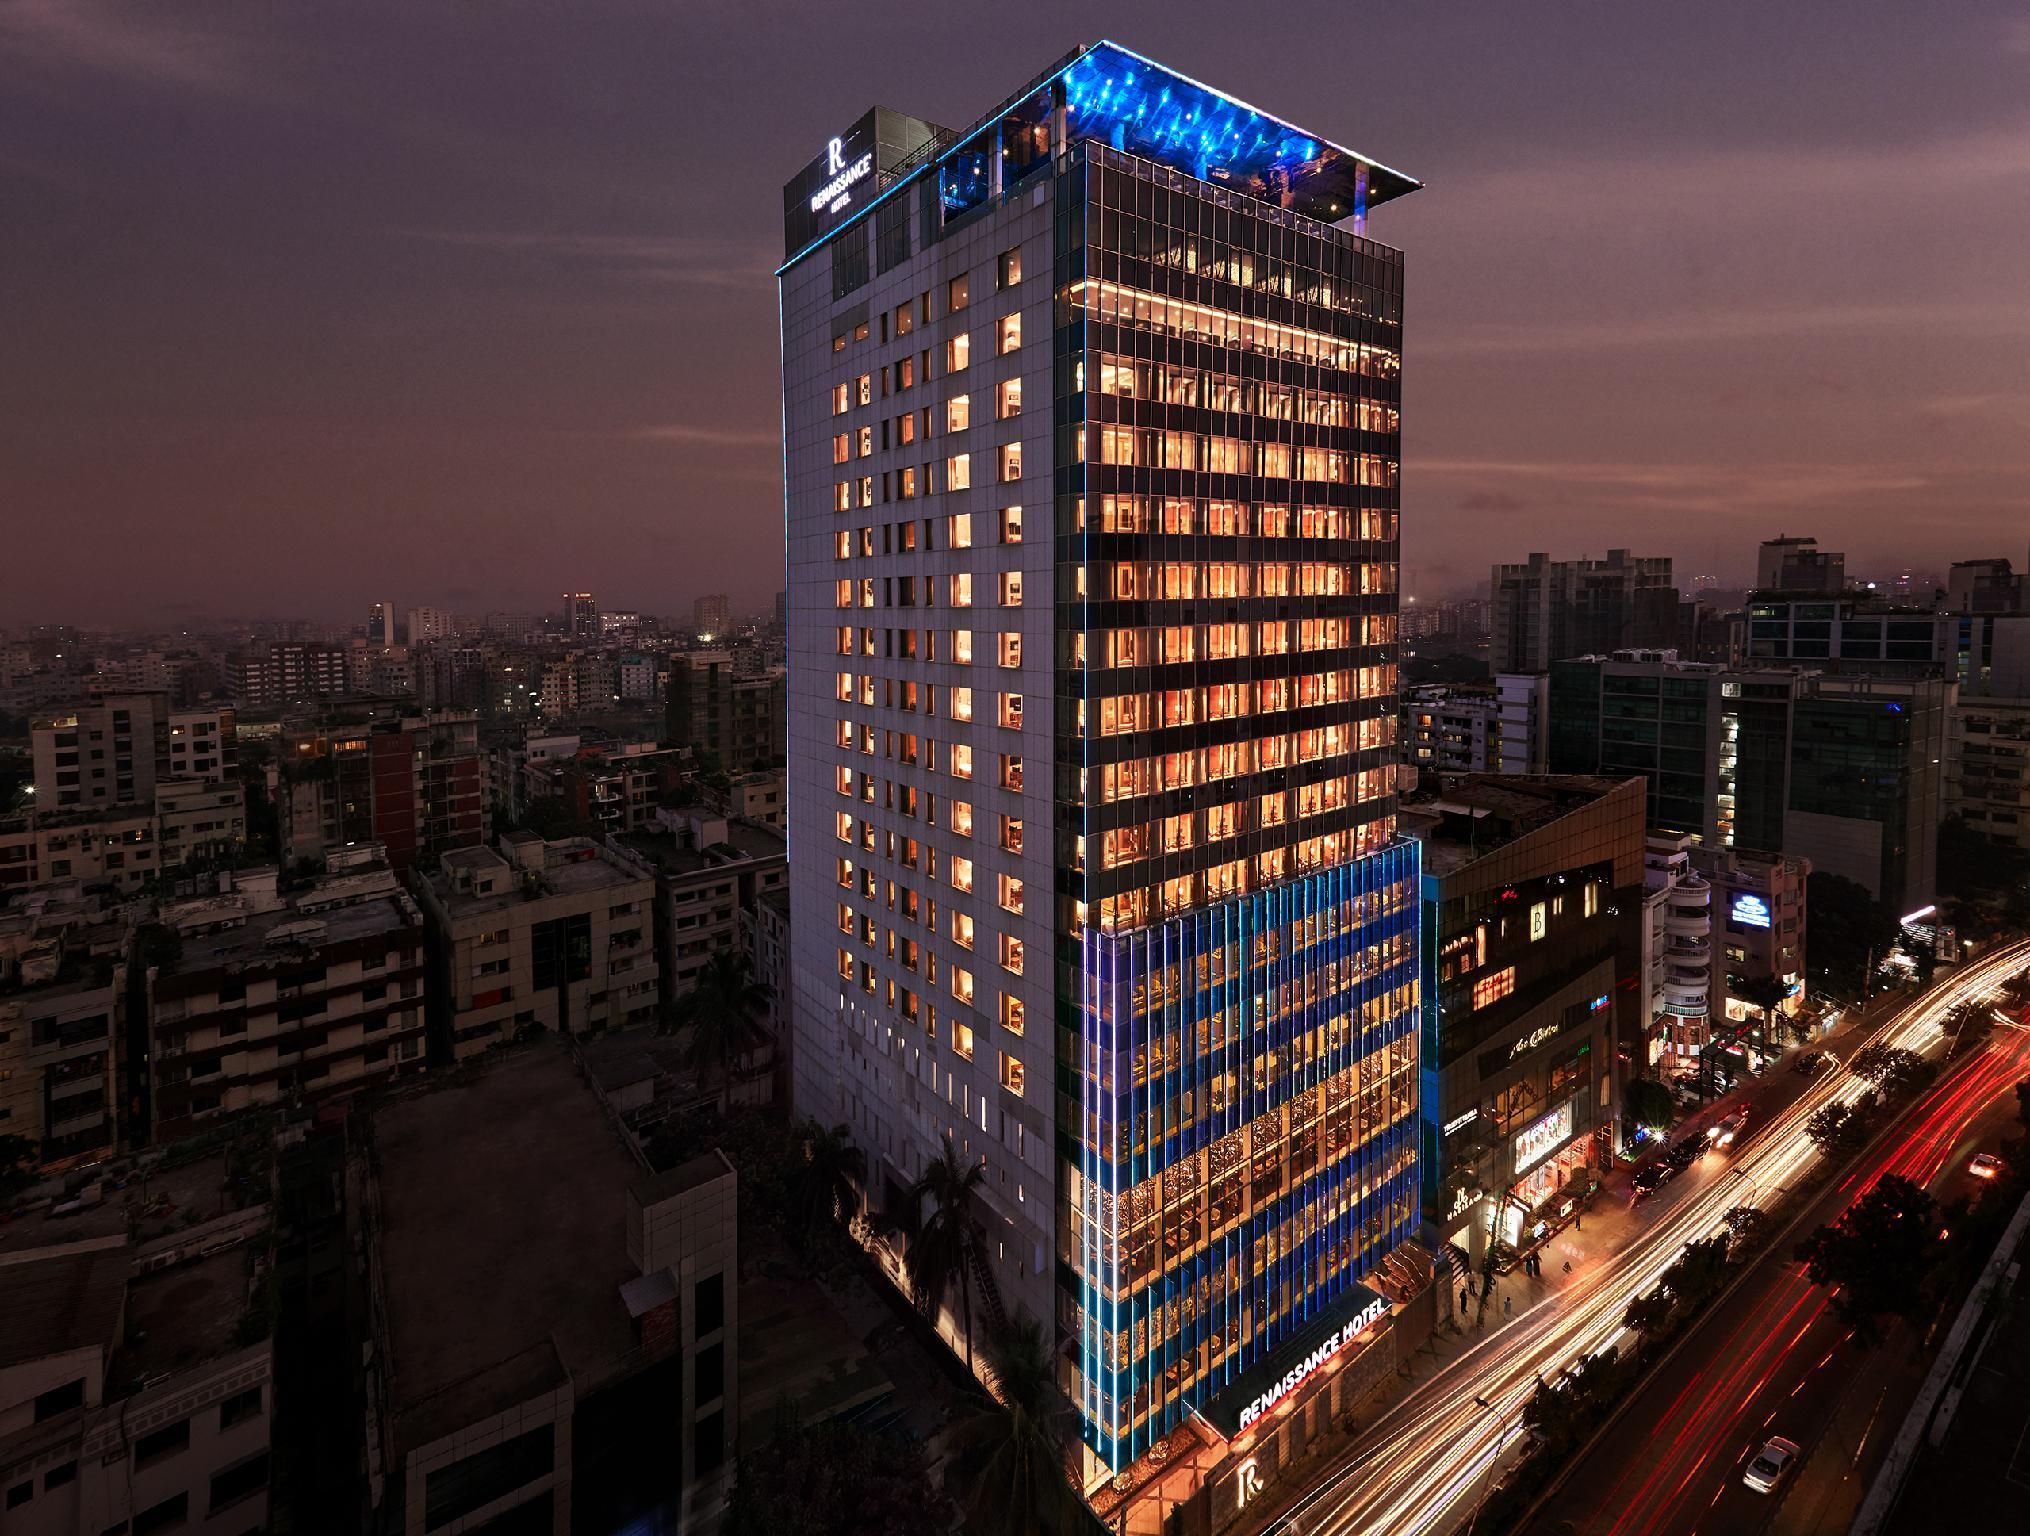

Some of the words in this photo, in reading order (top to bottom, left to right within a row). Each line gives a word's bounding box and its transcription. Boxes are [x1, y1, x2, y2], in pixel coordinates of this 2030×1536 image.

[828, 137, 846, 176] R
[811, 154, 872, 213] RENAISSANCE
[831, 192, 851, 213] HOTEL
[1240, 1332, 1340, 1430] RENAISSANCE
[1342, 1298, 1386, 1343] HOTEL
[1237, 1457, 1264, 1508] R
